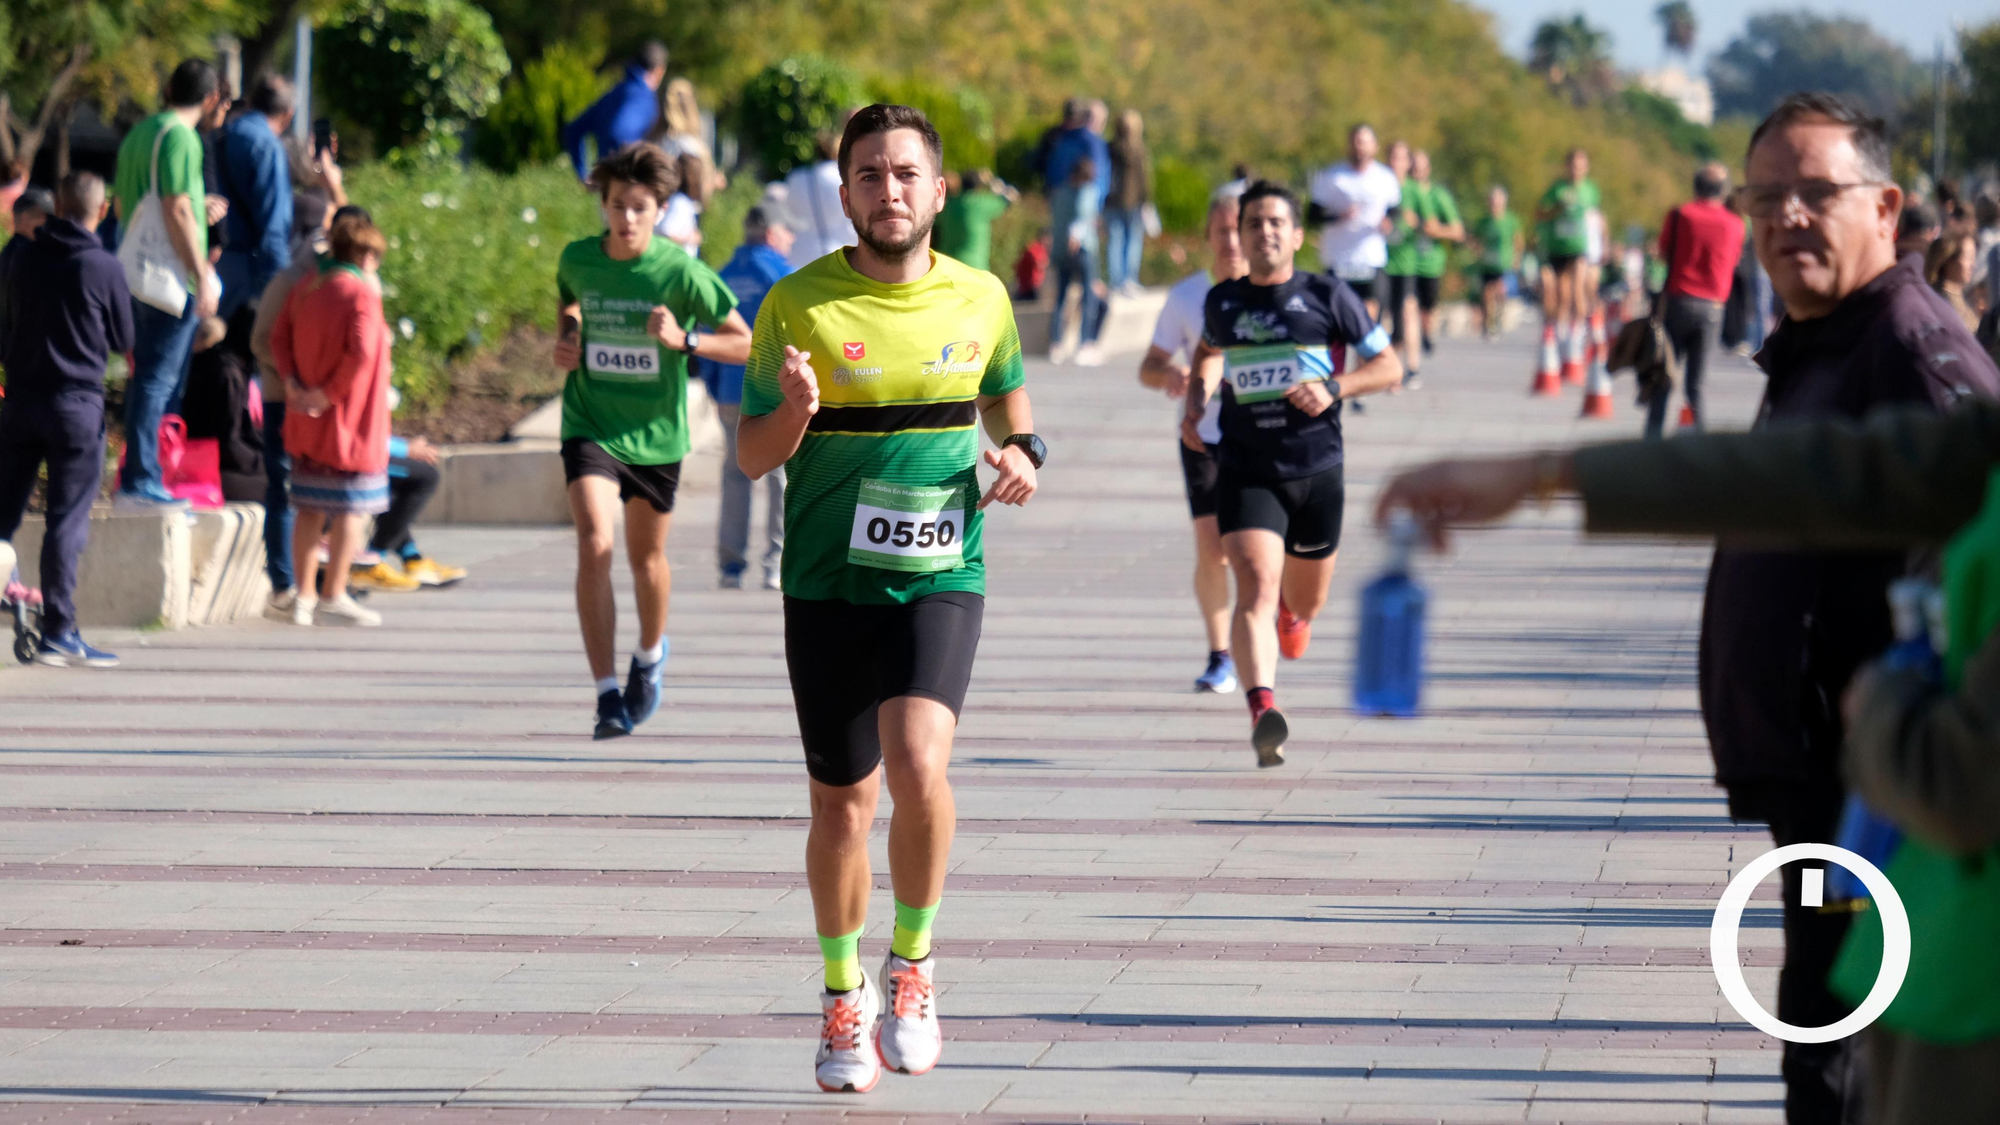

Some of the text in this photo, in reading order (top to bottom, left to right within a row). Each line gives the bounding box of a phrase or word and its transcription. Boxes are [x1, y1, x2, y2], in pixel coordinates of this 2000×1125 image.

[582, 298, 599, 311] En
[596, 351, 652, 370] 0486
[854, 367, 882, 376] EULEN
[1237, 367, 1292, 389] 0572
[855, 376, 882, 384] Sport
[867, 517, 954, 548] 0550
